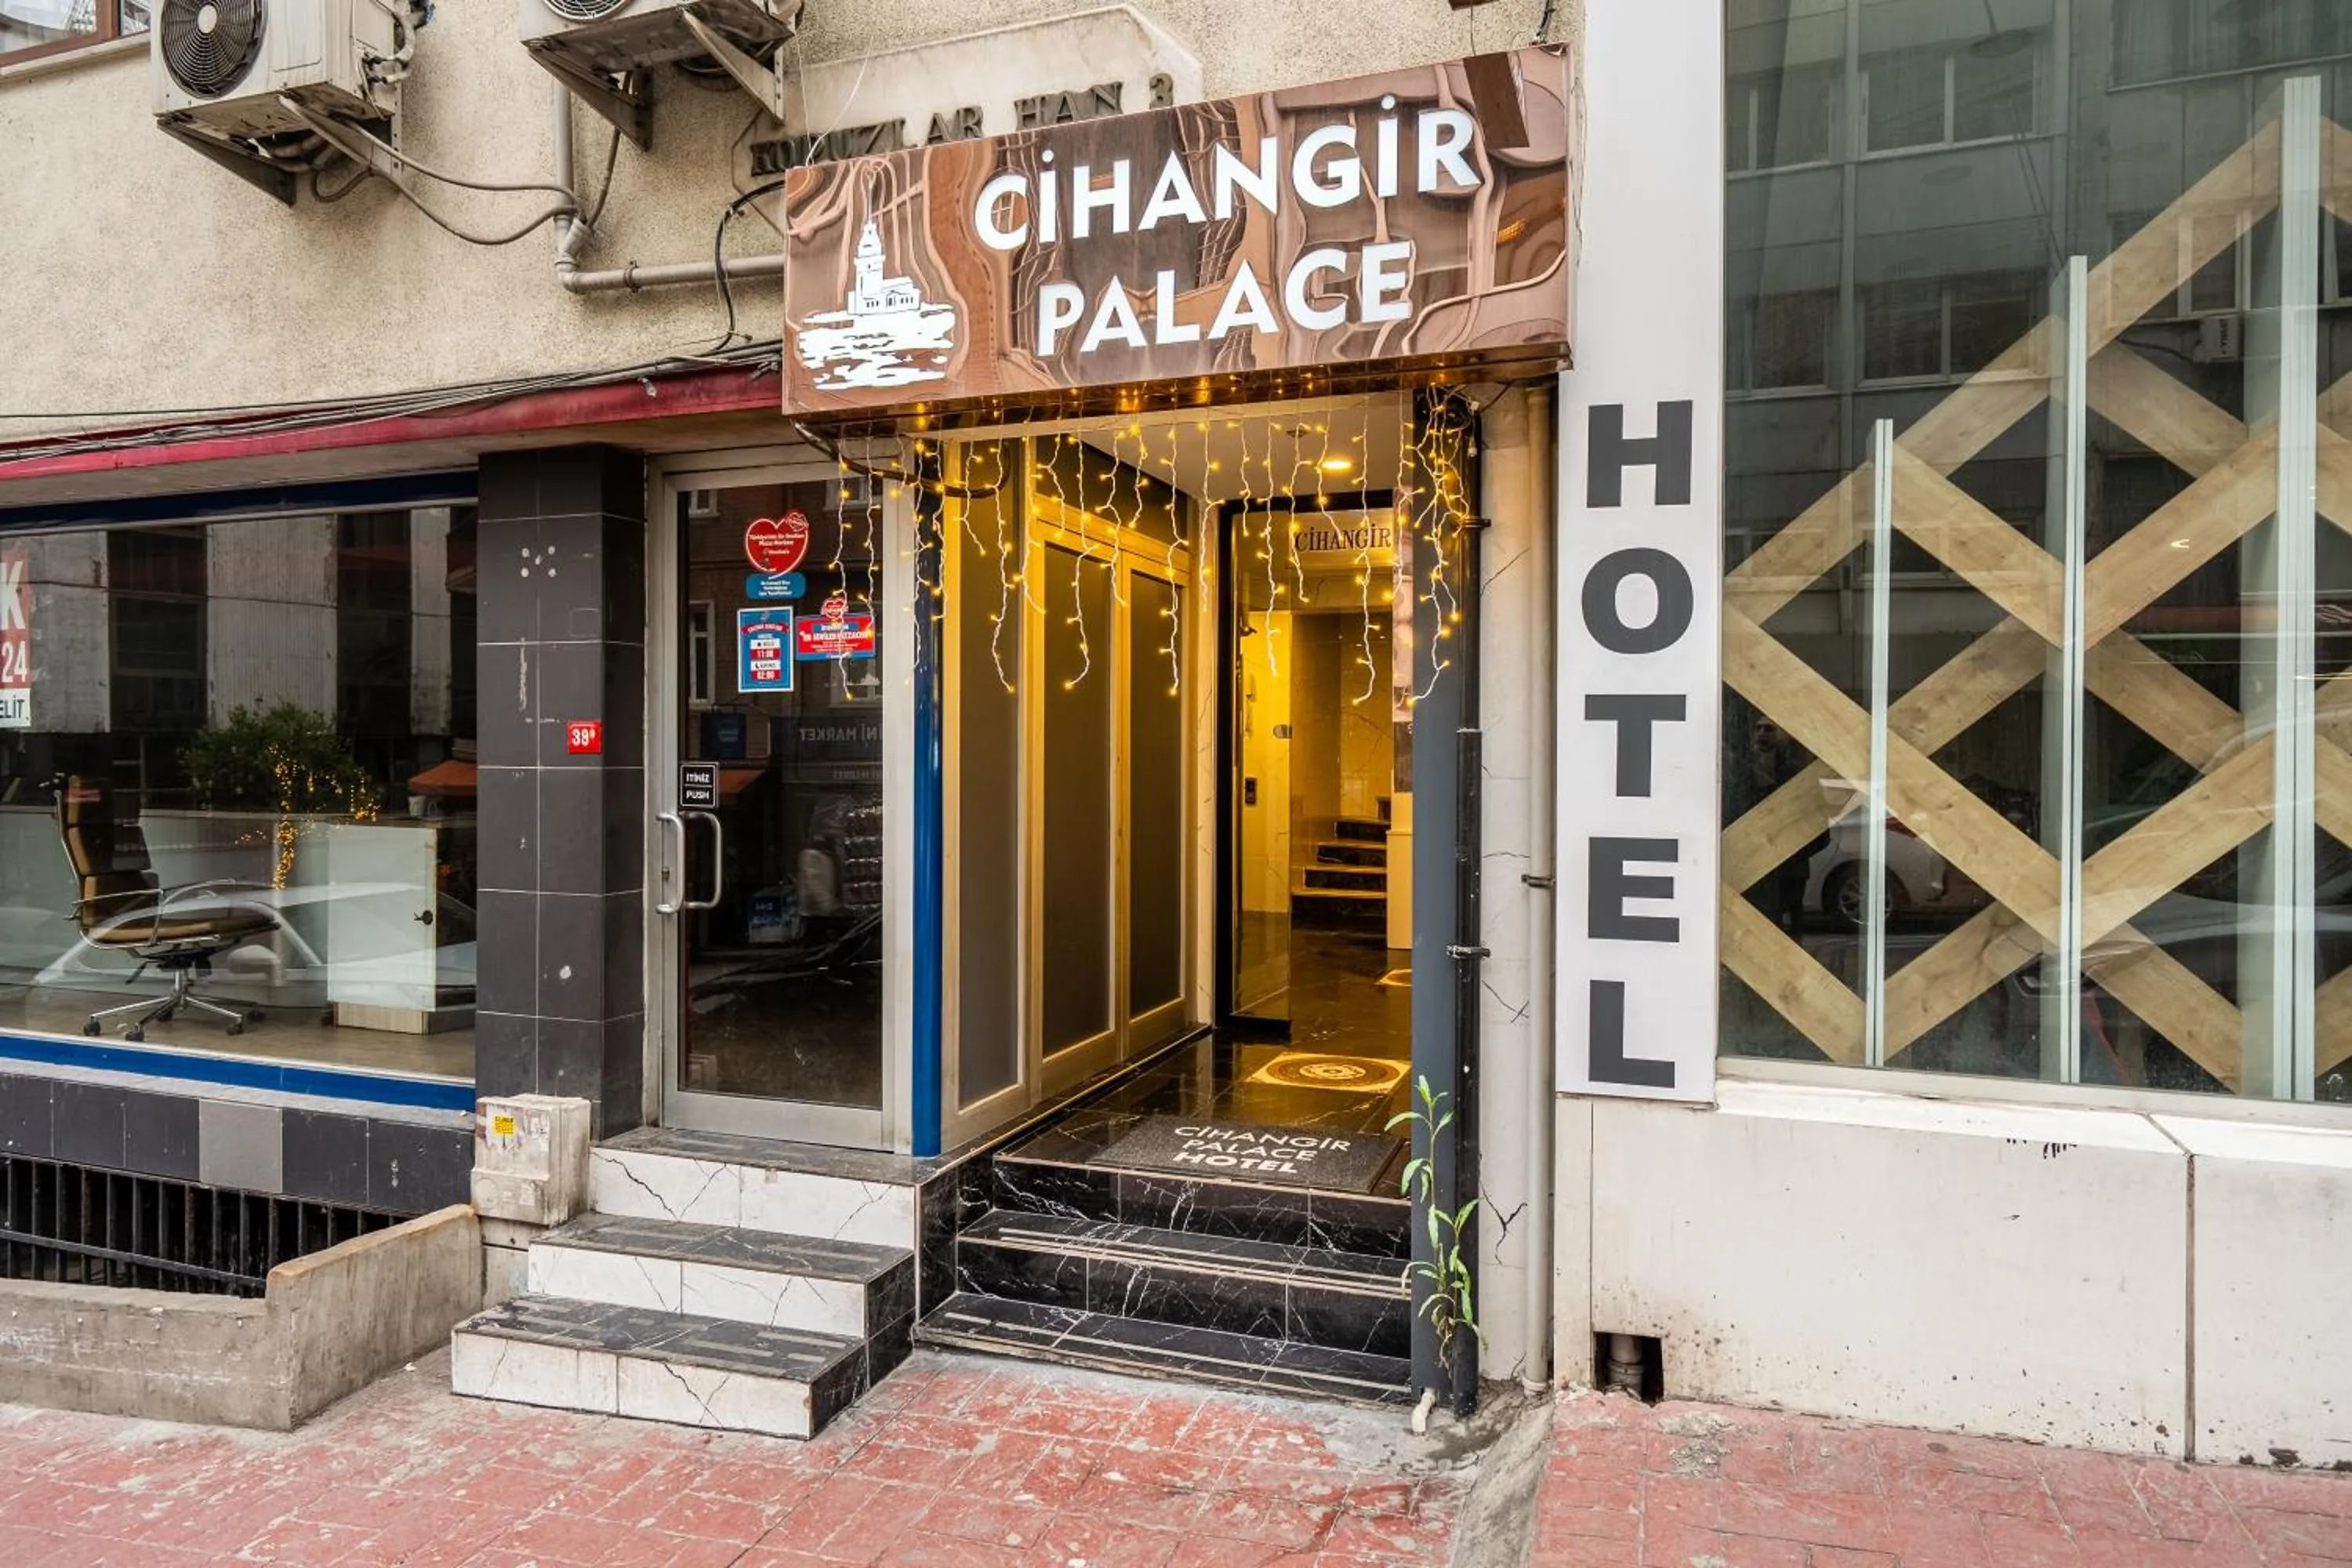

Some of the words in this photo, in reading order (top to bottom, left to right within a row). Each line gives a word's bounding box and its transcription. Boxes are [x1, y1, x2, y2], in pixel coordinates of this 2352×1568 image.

[1014, 82, 1124, 131] HAN
[975, 94, 1482, 251] CİHANGİR
[1038, 241, 1411, 357] PALACE
[2, 641, 27, 683] 24
[1581, 399, 1694, 1088] HOTEL
[686, 789, 710, 800] PUSH
[1172, 1152, 1298, 1174] HOTEL
[1182, 1139, 1318, 1161] PALACE
